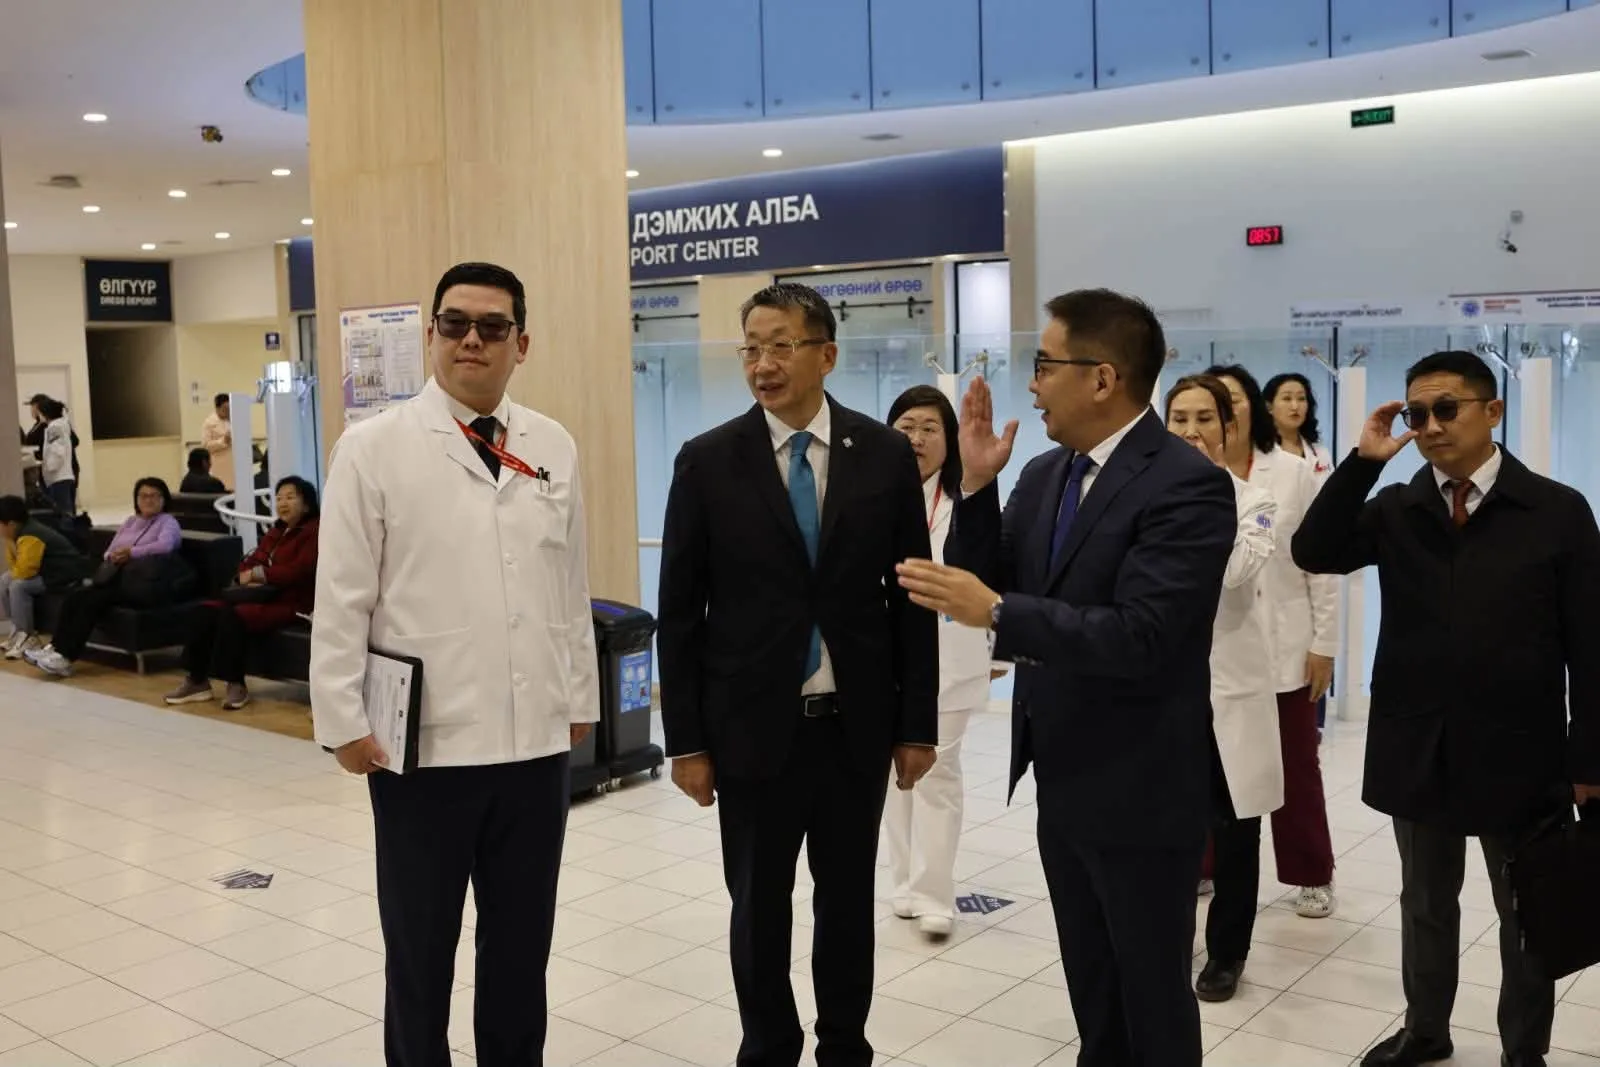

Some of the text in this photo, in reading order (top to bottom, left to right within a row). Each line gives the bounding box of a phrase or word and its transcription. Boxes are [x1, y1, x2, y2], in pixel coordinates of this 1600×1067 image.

[632, 193, 820, 243] ДЭМЖИХ АЛБА
[630, 236, 760, 267] PORT CENTER
[885, 279, 923, 294] ӨРӨӨ
